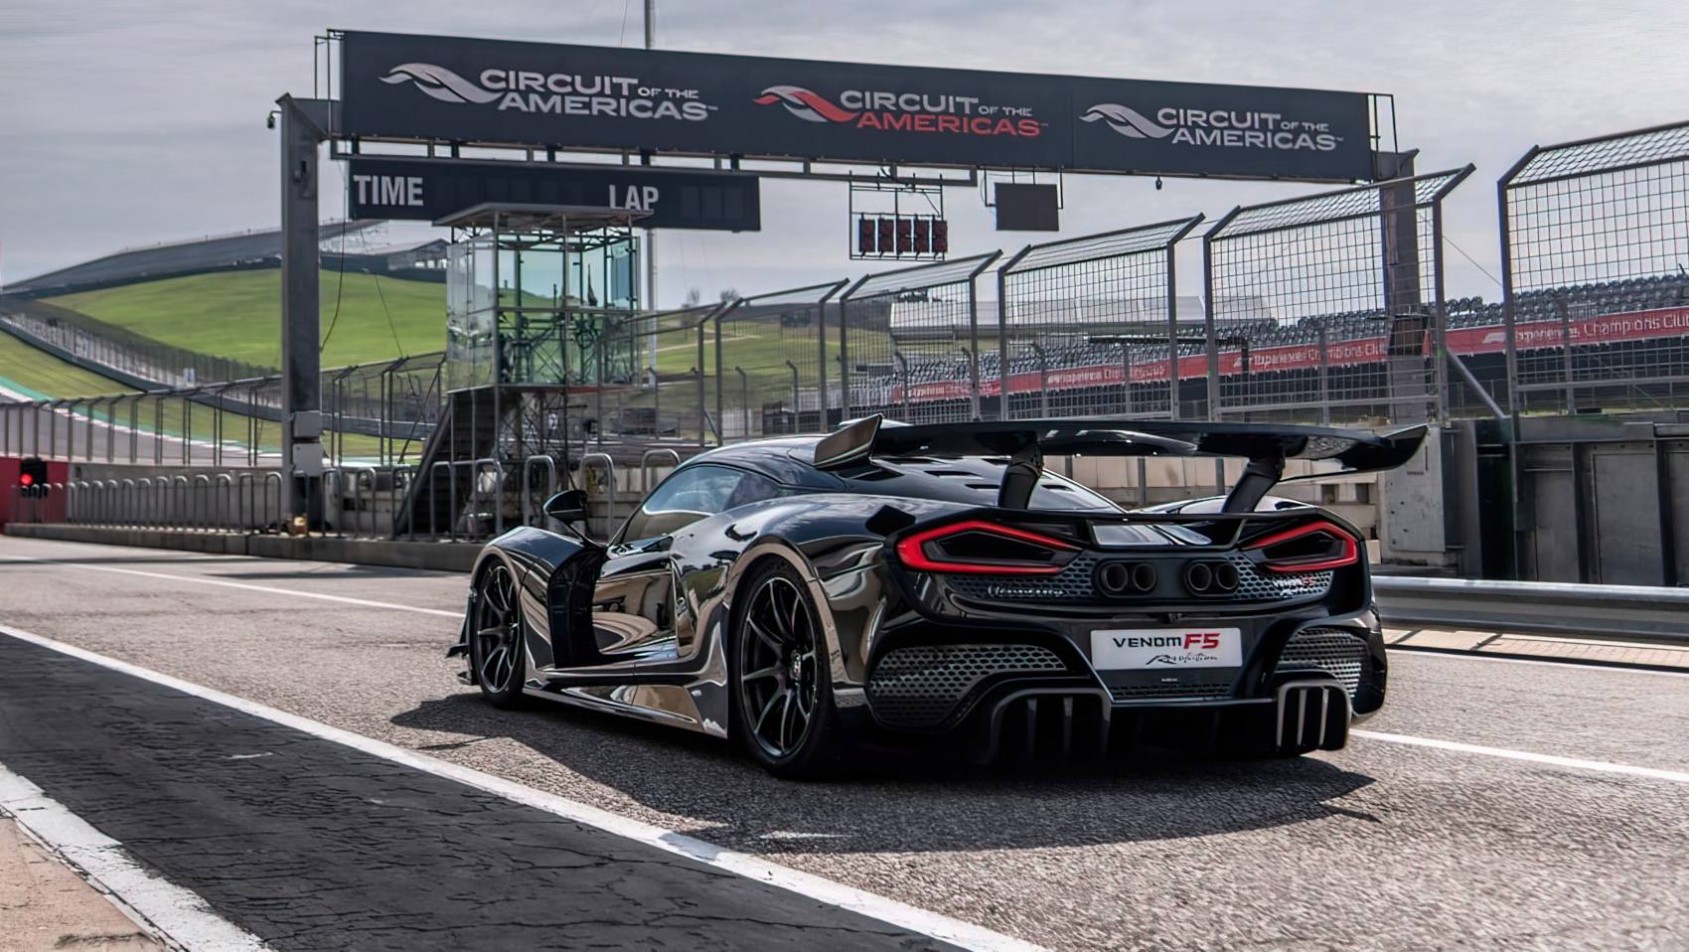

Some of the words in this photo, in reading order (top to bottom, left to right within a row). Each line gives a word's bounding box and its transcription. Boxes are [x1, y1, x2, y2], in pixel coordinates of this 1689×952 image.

[480, 68, 639, 96] CIRCUIT
[637, 86, 659, 97] OF
[664, 88, 700, 99] THE
[840, 89, 979, 114] CIRCUIT
[978, 104, 999, 115] OF
[1002, 106, 1033, 117] THE
[1156, 107, 1282, 130] CIRCUIT
[1280, 120, 1298, 130] OF
[1301, 121, 1330, 132] THE
[353, 174, 425, 207] TIME
[609, 184, 660, 211] LAP
[1112, 636, 1182, 648] VENOM
[1183, 633, 1221, 649] F5
